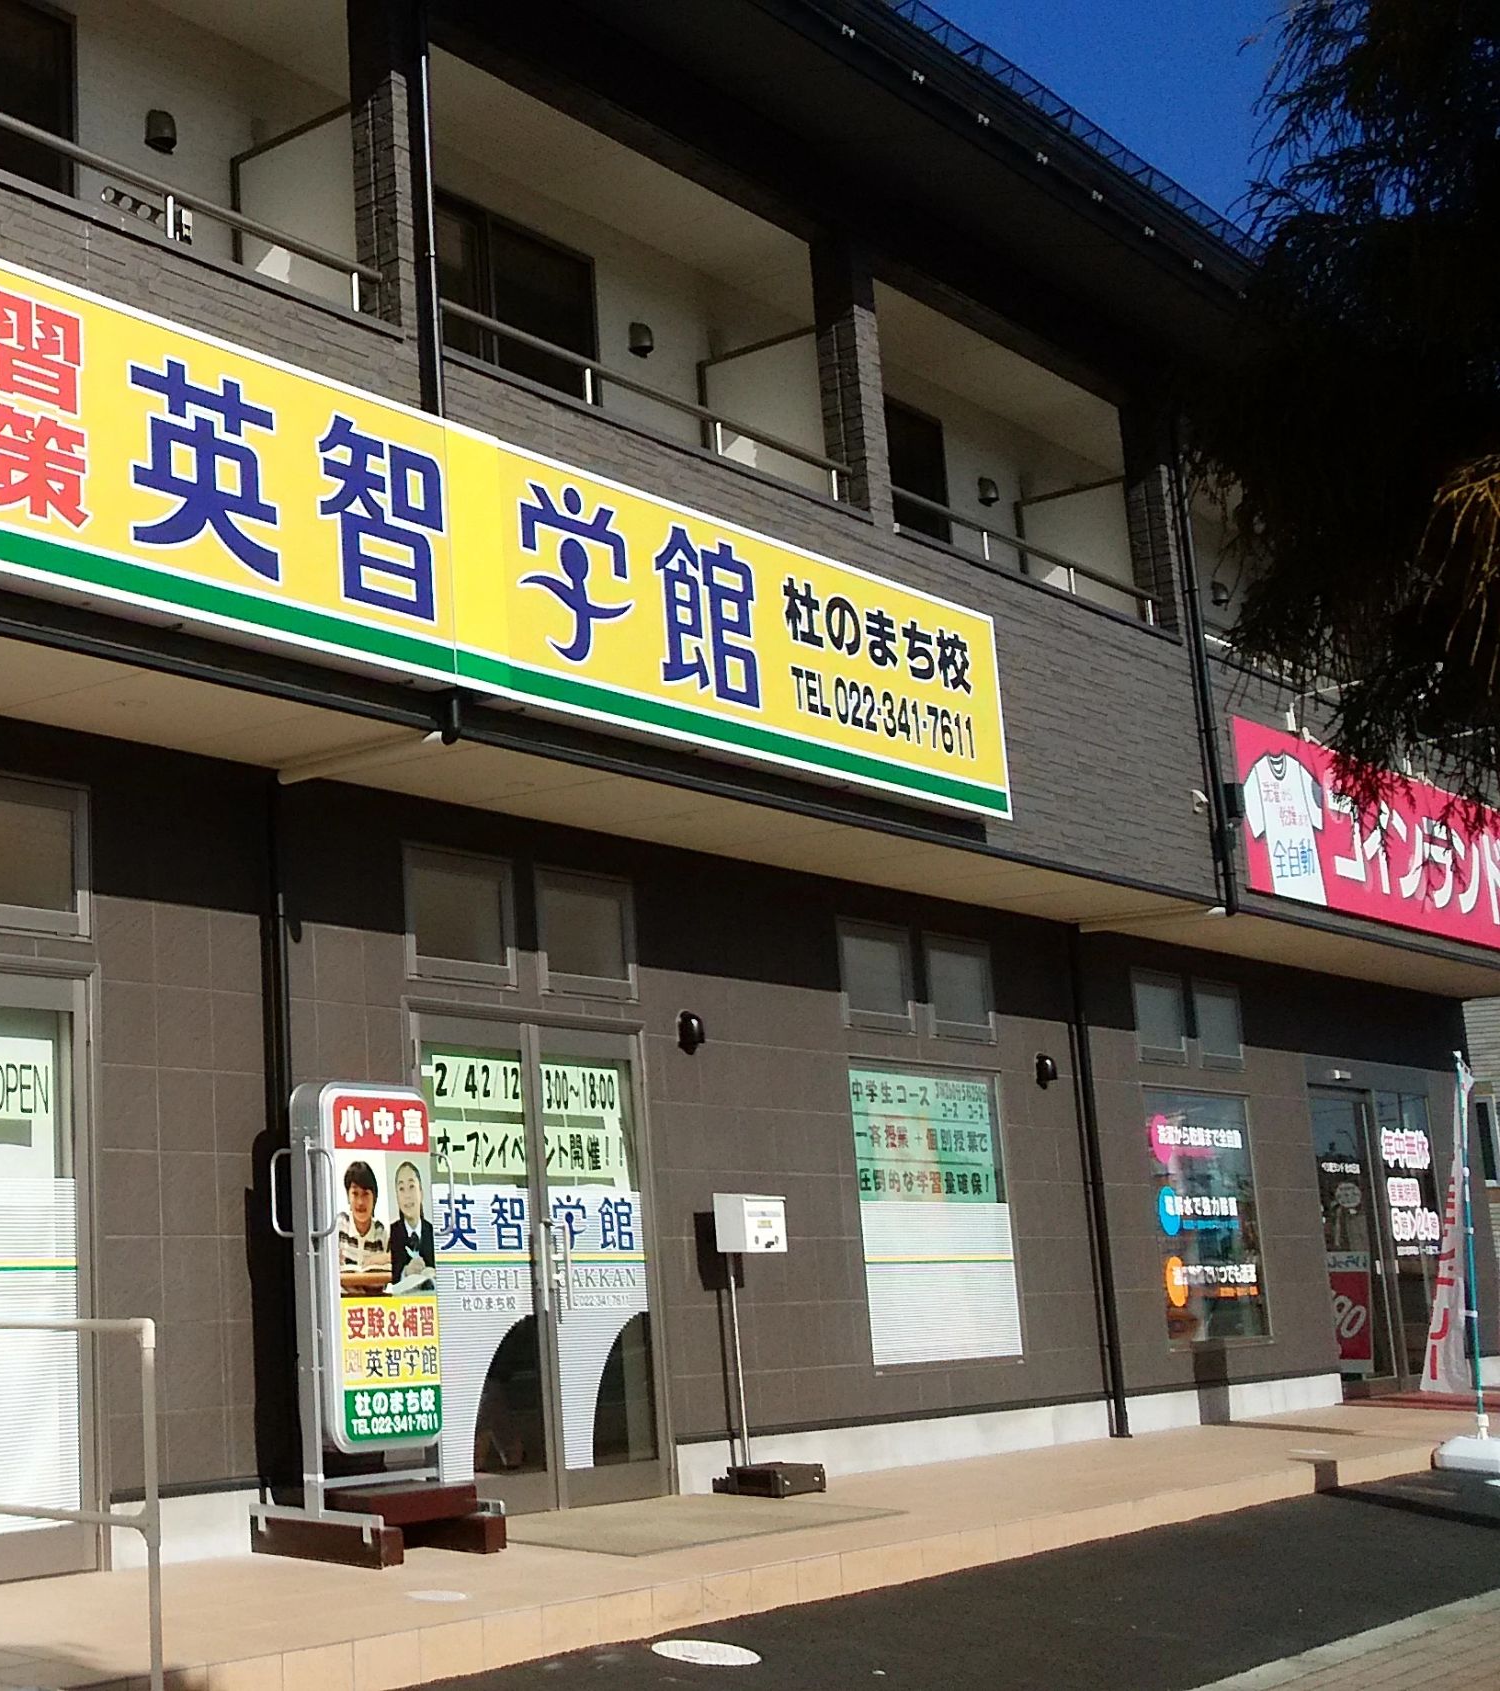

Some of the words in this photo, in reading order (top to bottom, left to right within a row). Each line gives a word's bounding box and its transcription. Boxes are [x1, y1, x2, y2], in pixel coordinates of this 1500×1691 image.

[129, 356, 763, 709] 英智学館
[782, 577, 972, 695] 杜のまち校
[790, 665, 832, 718] TEL
[834, 676, 976, 759] 022-341-7611
[1273, 838, 1316, 879] 全自動
[851, 1077, 930, 1106] 中学生コース
[438, 1193, 635, 1251] 英智学館
[455, 1269, 520, 1290] EICHI
[365, 1345, 438, 1378] 英智学館
[354, 1387, 436, 1417] 杜のまち校
[351, 1418, 371, 1435] TEL
